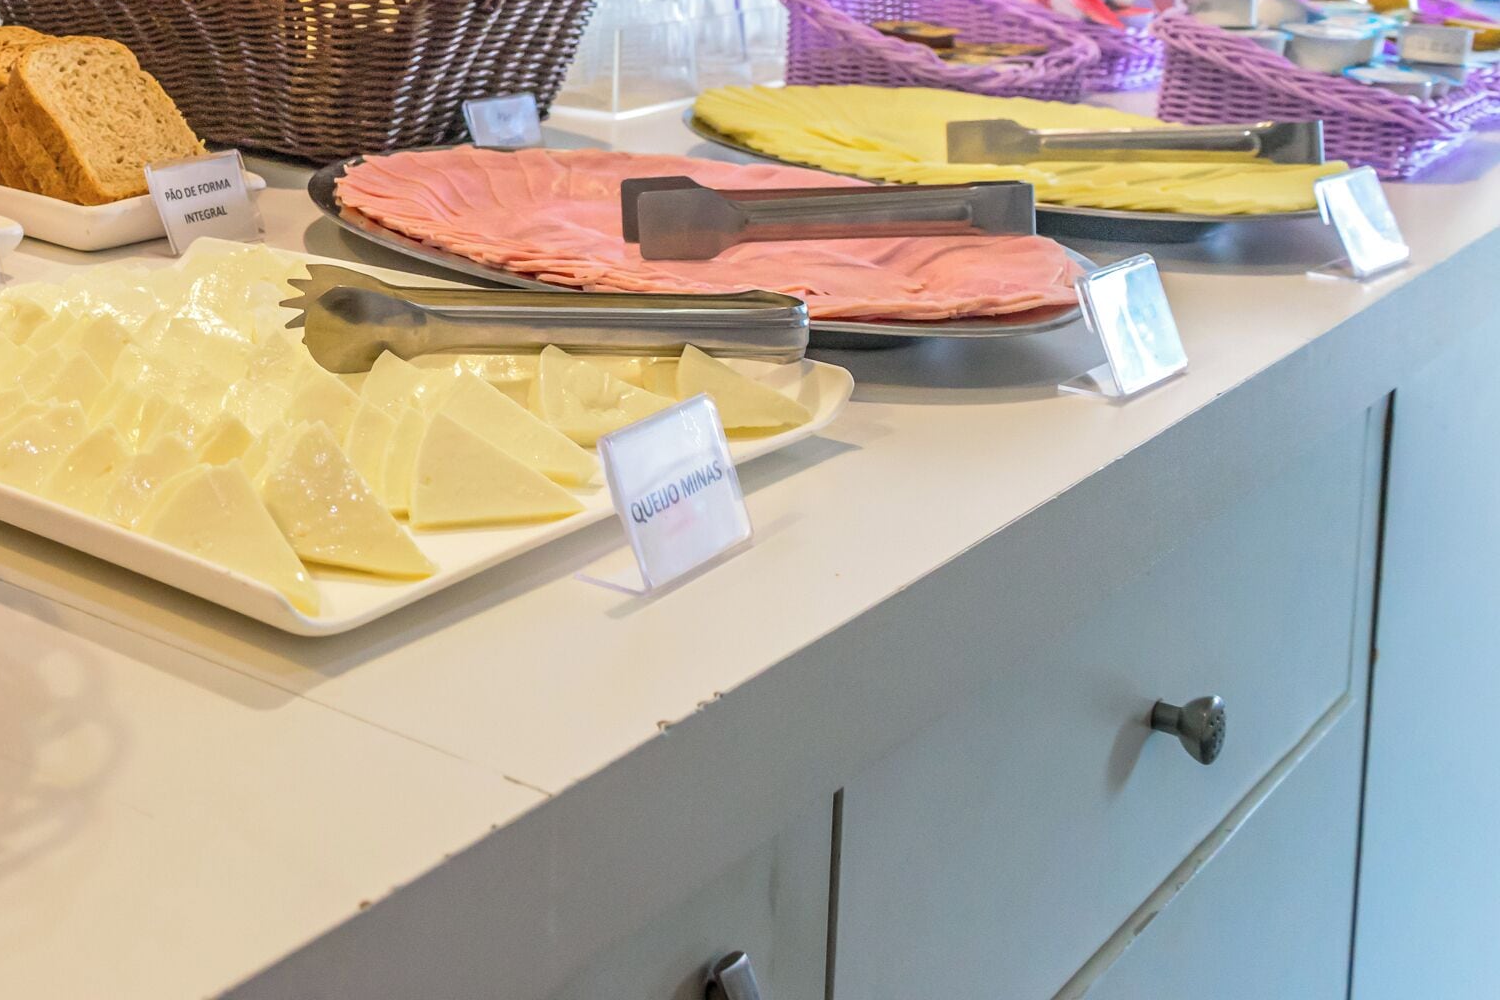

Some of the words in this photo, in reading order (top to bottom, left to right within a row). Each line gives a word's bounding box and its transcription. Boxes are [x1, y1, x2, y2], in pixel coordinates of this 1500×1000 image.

[165, 187, 183, 201] PÃO
[184, 185, 197, 198] DE
[198, 178, 231, 195] FORMA
[184, 205, 227, 224] INTEGRAL
[631, 483, 680, 523] QUEIJO
[680, 460, 723, 499] MINAS
